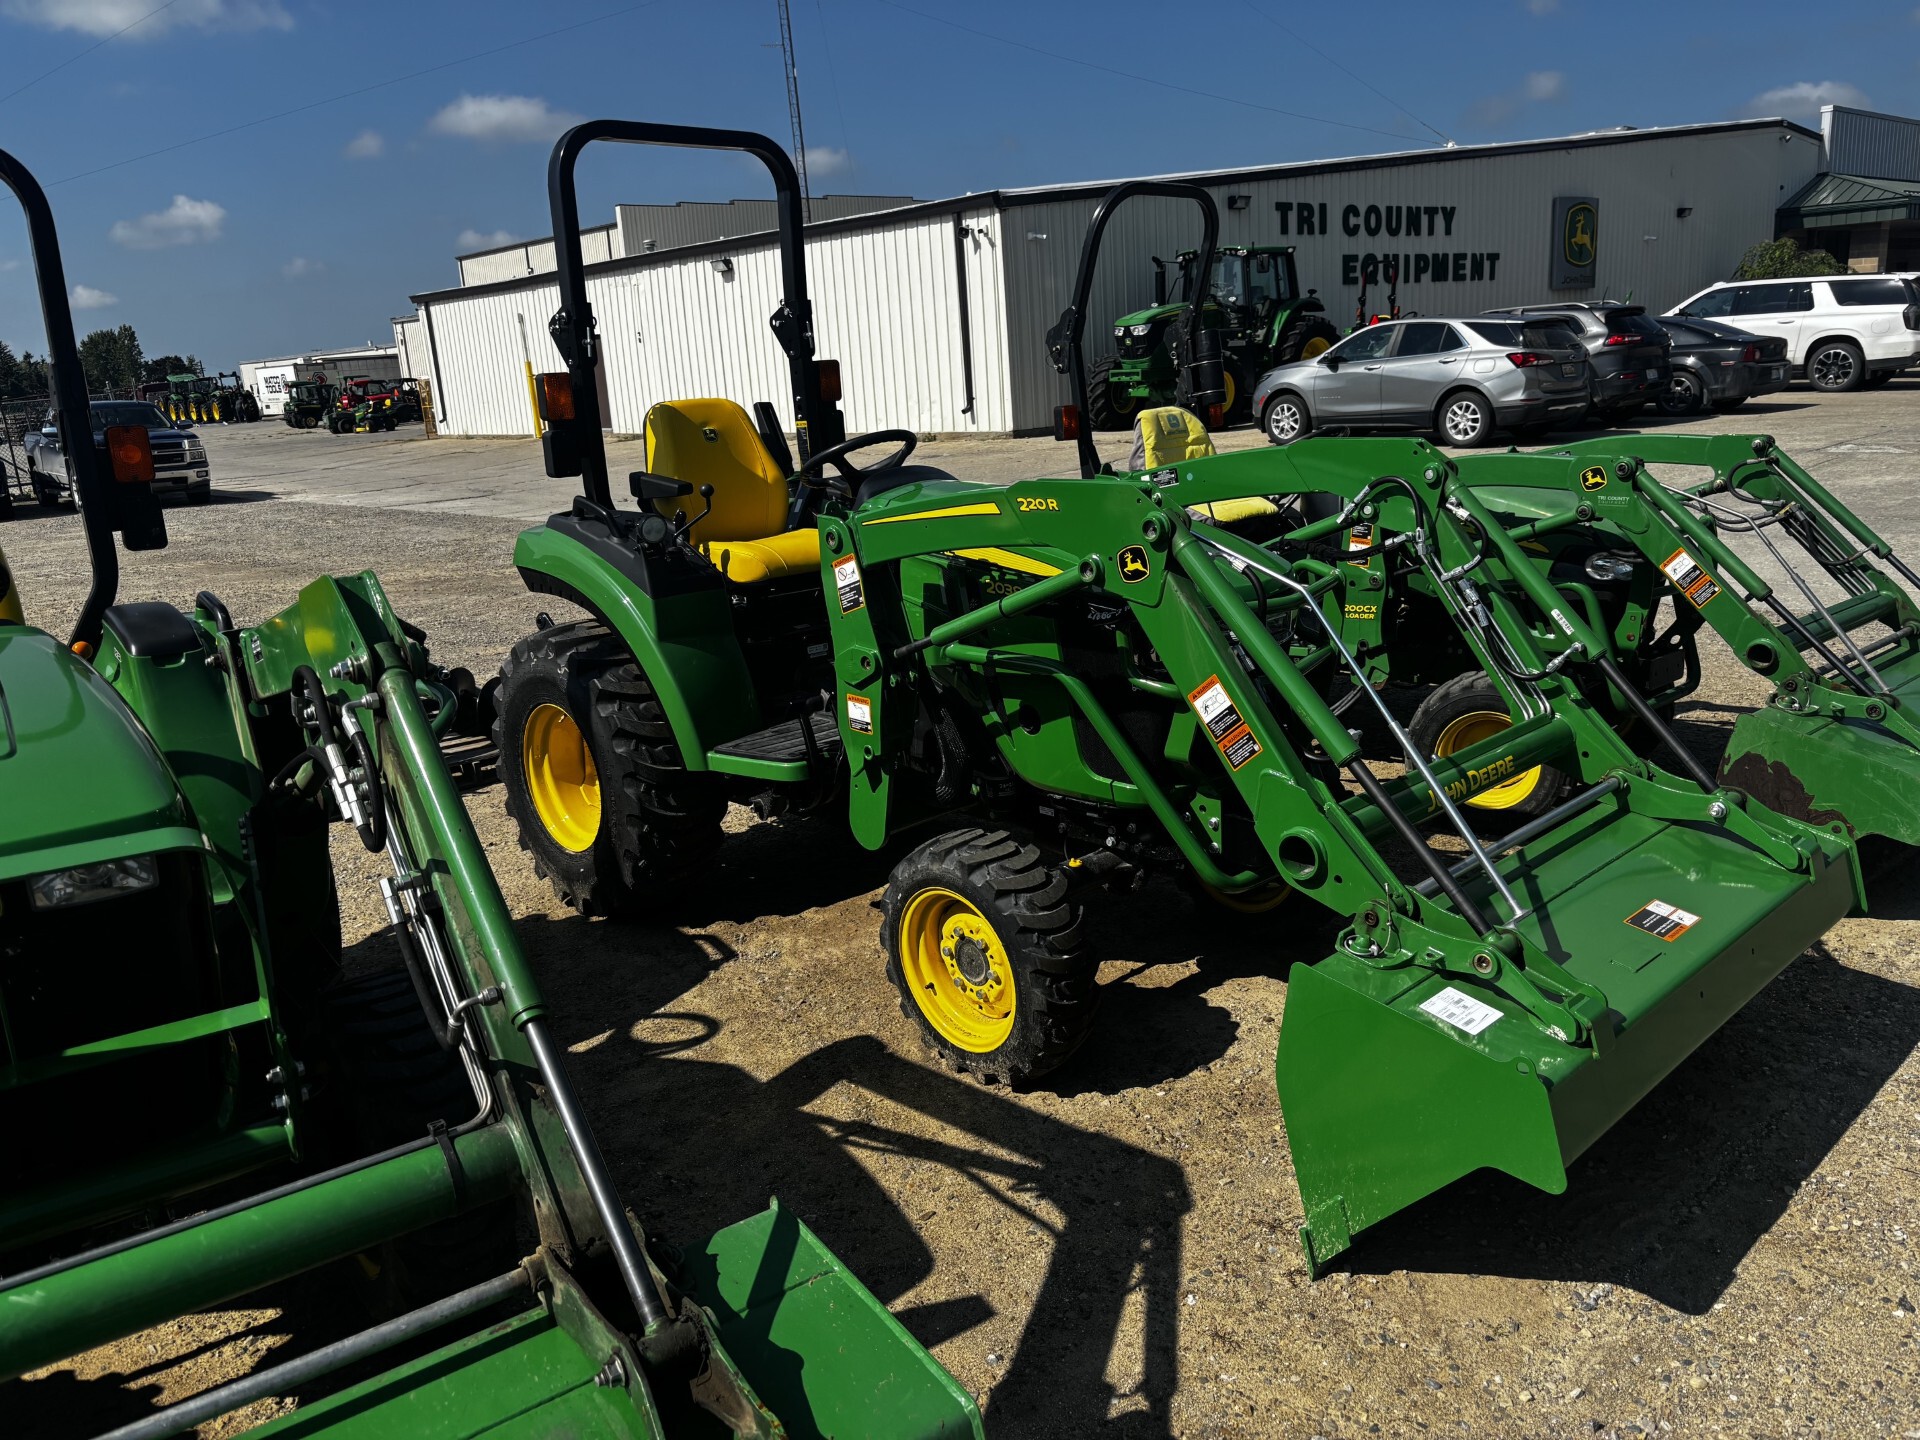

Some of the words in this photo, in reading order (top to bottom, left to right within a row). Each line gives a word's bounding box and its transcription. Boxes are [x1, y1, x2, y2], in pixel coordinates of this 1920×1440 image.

[1275, 201, 1327, 235] TRI
[1342, 204, 1456, 237] COUNTY
[1342, 252, 1500, 285] EQUIPMENT
[266, 385, 282, 393] TOOLS
[1344, 604, 1377, 613] 200CX
[1345, 612, 1375, 620] LOADER
[1466, 755, 1516, 792] DEERE
